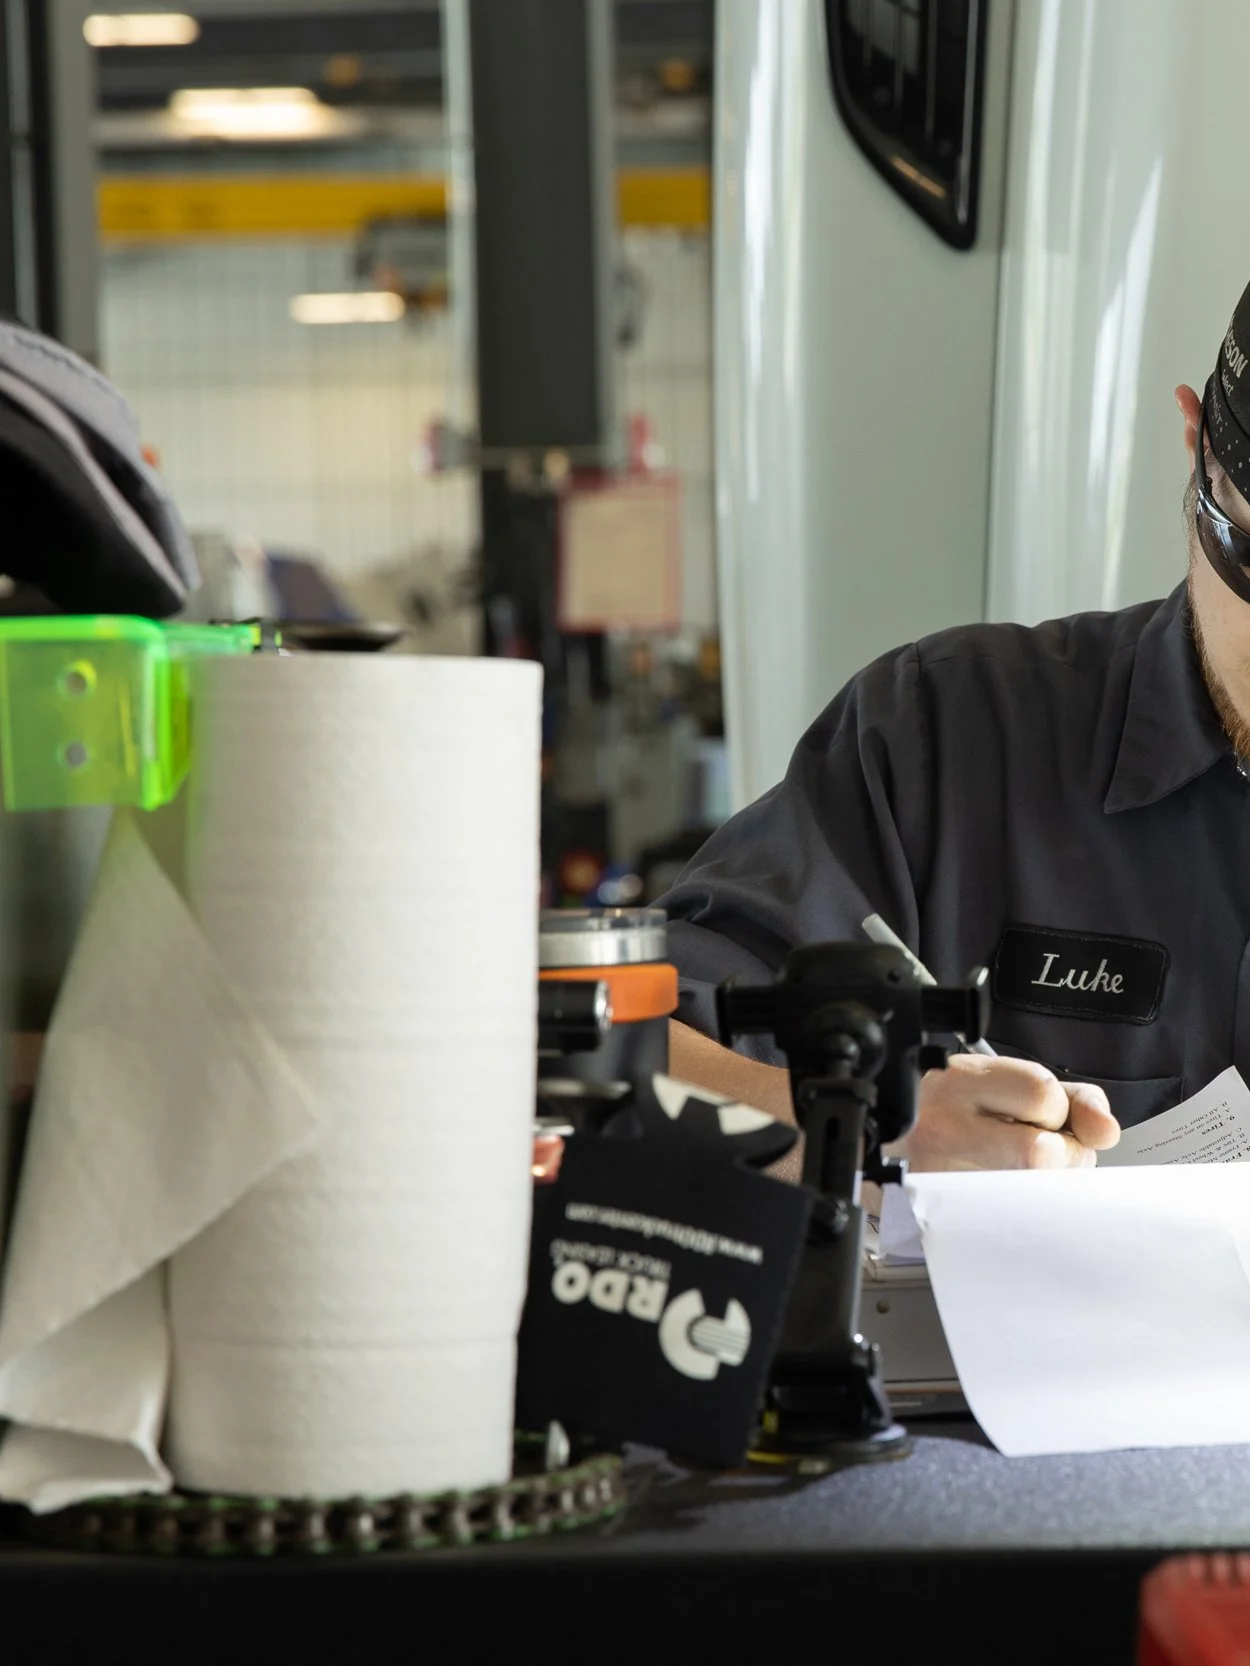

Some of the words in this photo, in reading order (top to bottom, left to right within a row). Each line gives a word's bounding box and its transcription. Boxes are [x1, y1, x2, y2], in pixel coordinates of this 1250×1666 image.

[1031, 952, 1125, 994] Luke
[1154, 1135, 1182, 1147] Steering
[1201, 1121, 1226, 1135] Tires
[551, 1261, 670, 1323] RDO
